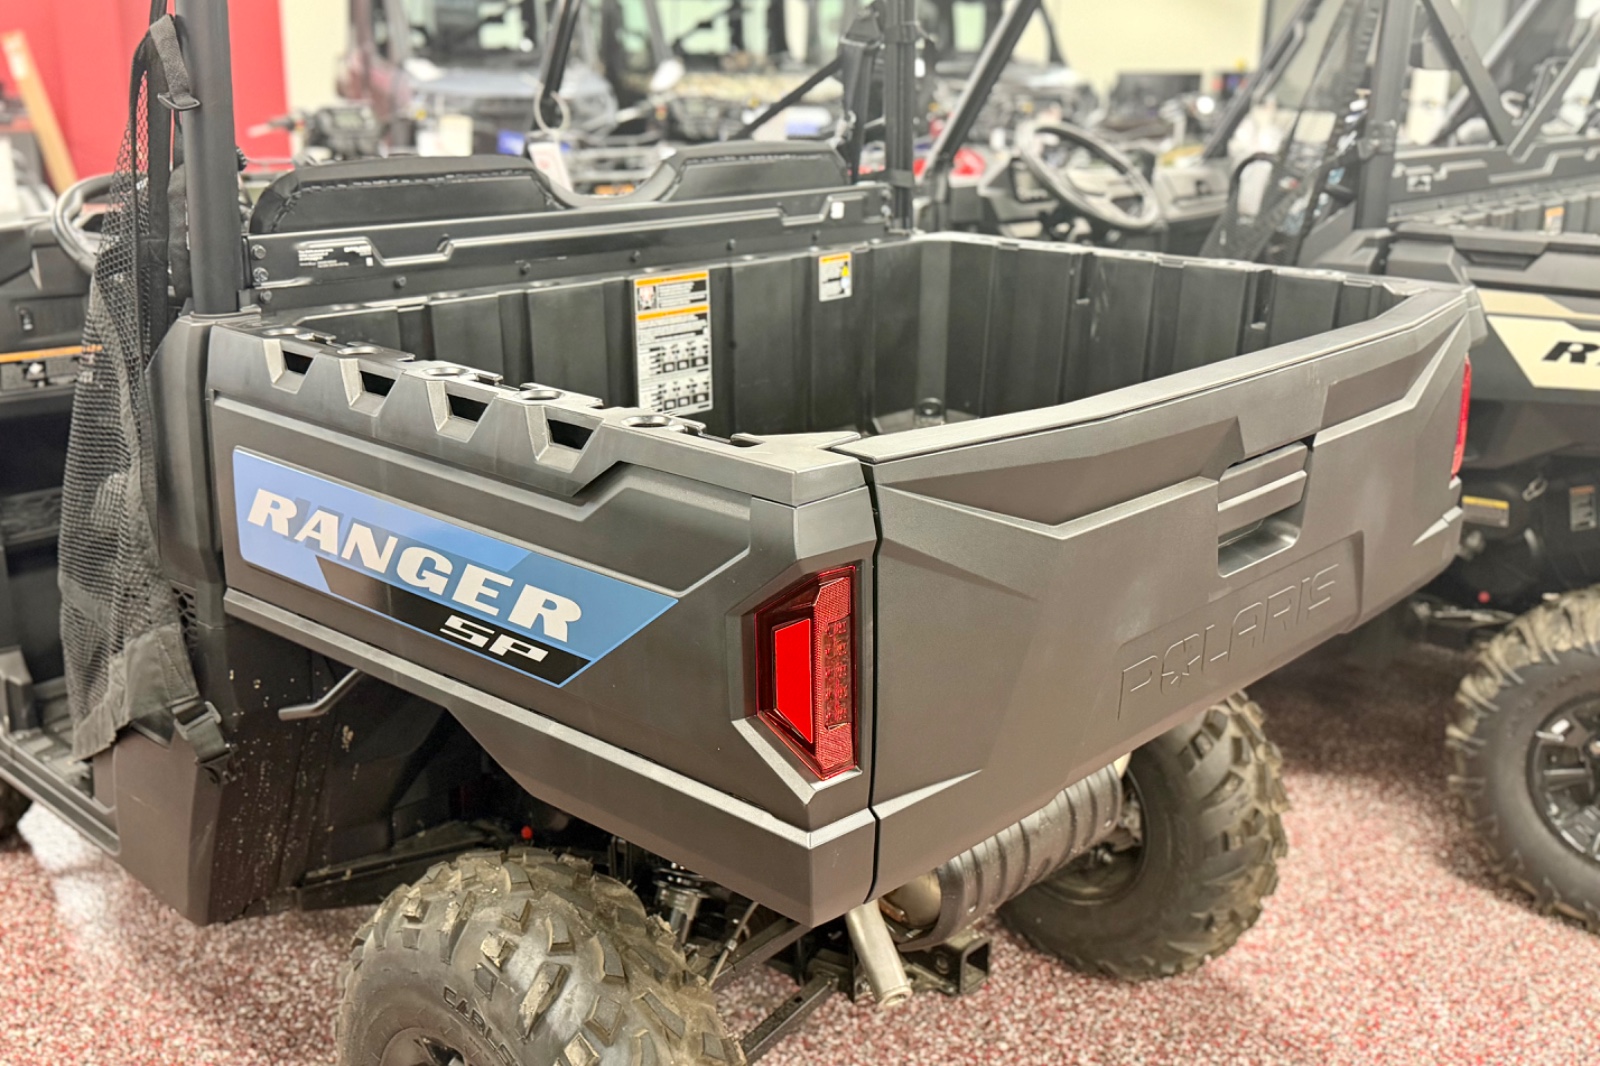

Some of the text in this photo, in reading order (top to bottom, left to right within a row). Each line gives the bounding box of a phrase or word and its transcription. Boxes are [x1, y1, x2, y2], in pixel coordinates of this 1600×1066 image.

[1541, 341, 1600, 366] R
[247, 488, 583, 643] RANGER
[439, 614, 549, 662] SP
[1117, 563, 1339, 721] POLARIS
